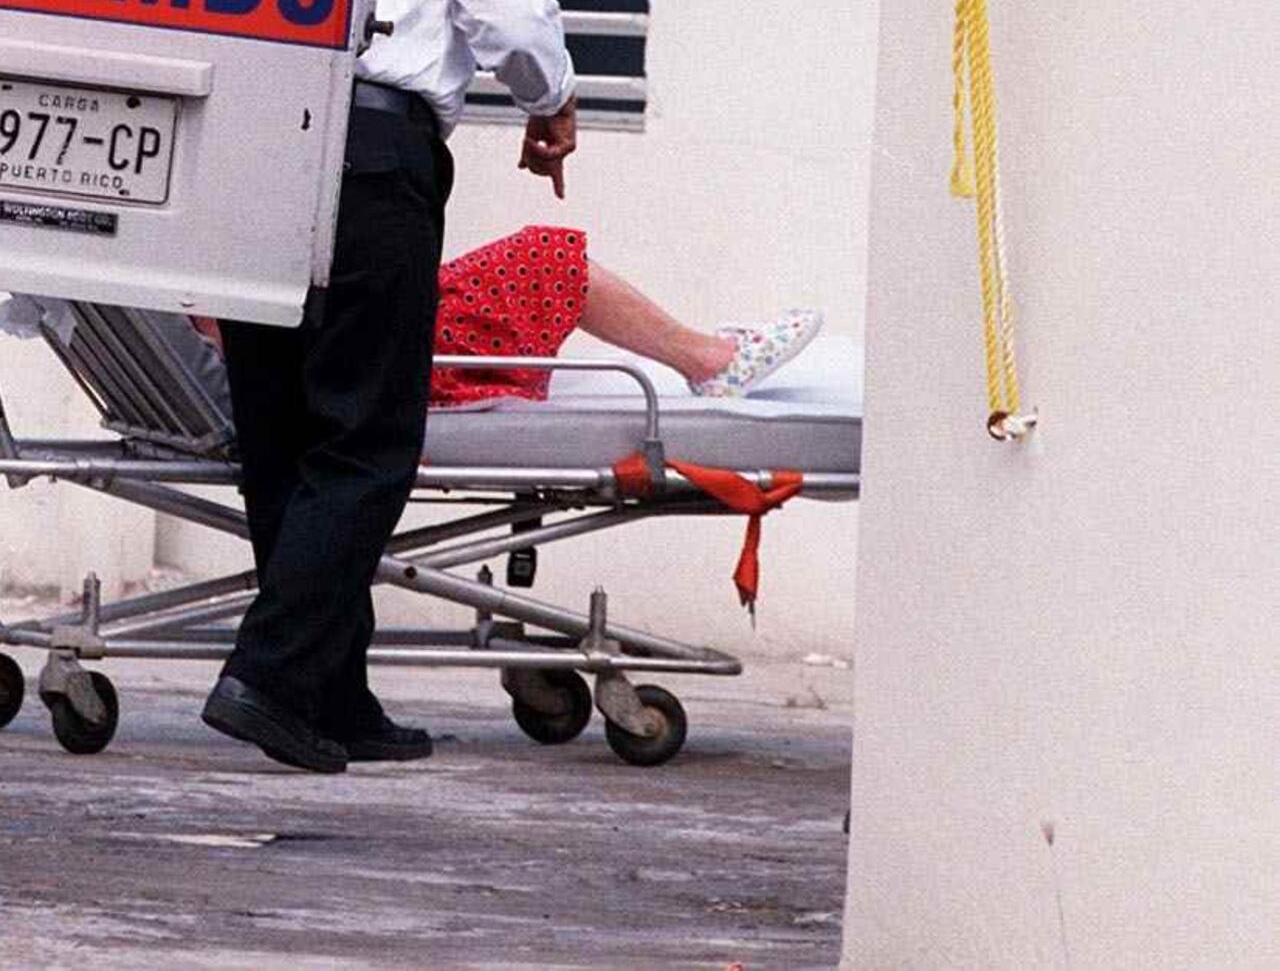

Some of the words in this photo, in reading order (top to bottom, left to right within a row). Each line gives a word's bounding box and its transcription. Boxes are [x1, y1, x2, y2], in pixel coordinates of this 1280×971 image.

[38, 93, 100, 112] CARGA
[0, 162, 72, 184] PUERTO
[80, 172, 122, 189] RICO
